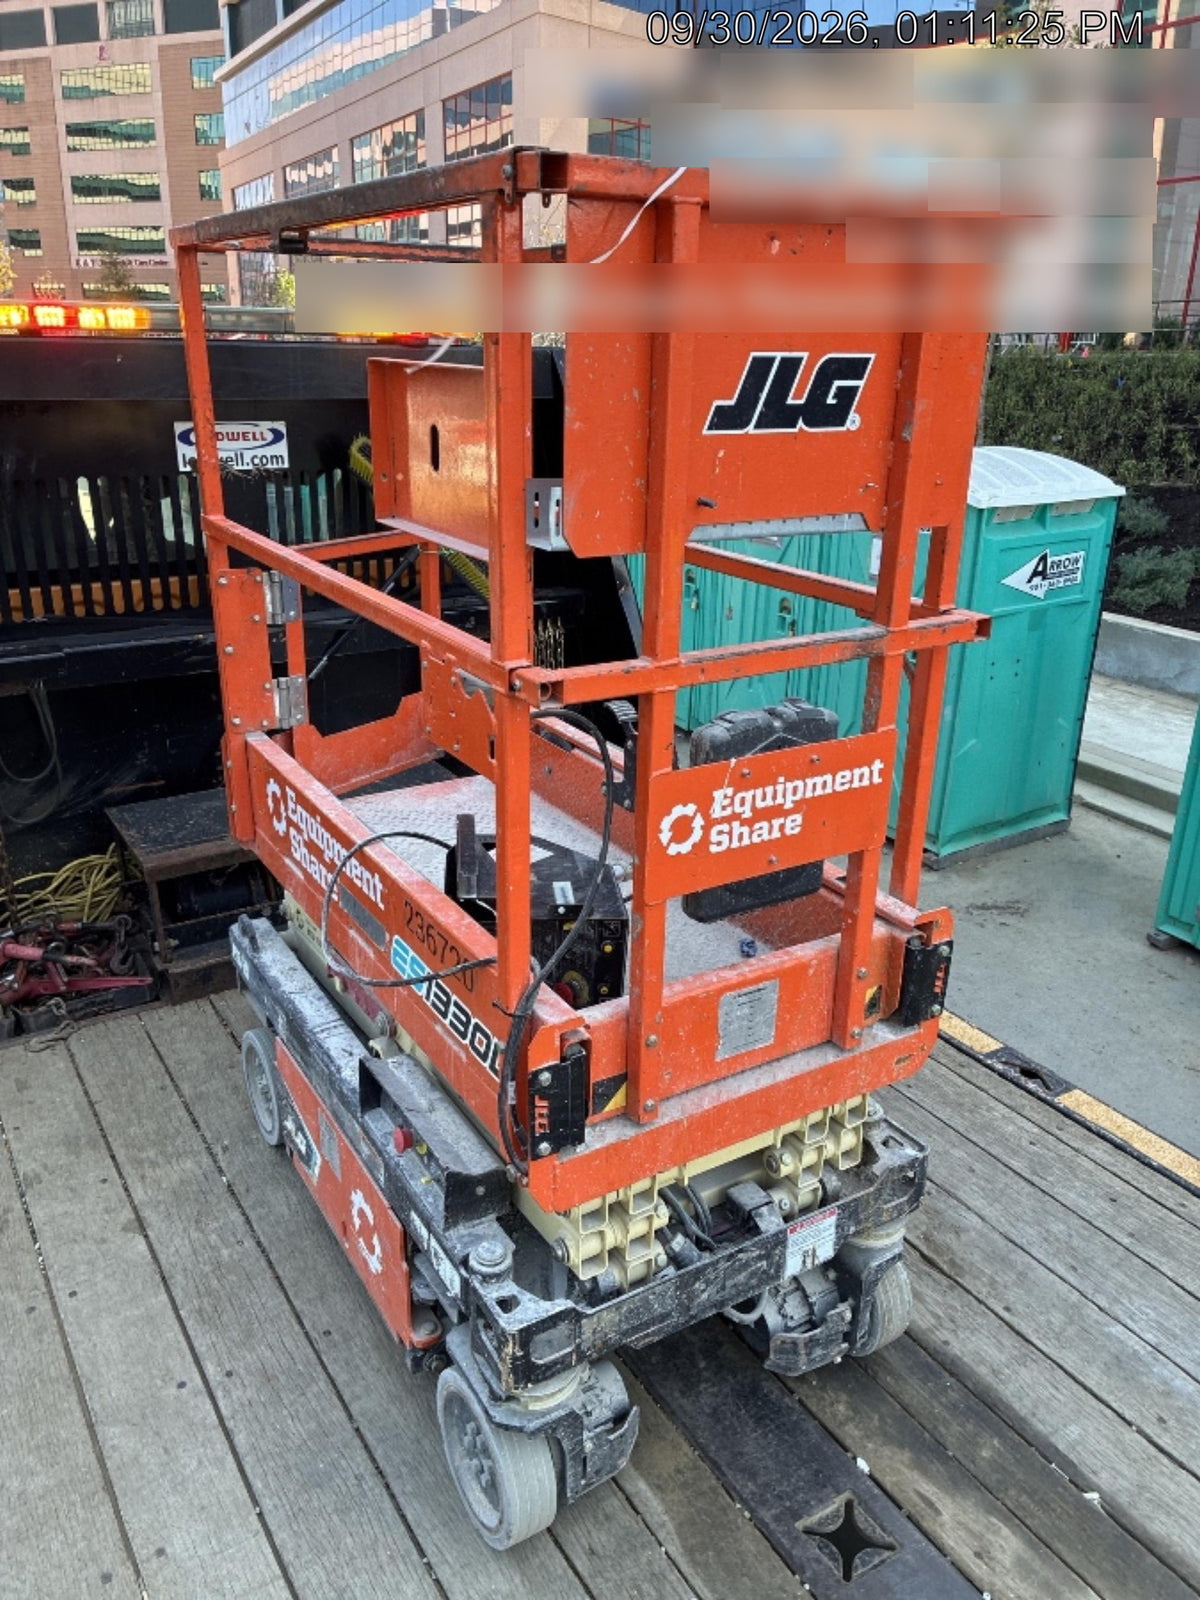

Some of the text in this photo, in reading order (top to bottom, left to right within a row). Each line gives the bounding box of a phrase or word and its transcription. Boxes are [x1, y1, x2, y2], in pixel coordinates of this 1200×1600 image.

[702, 352, 877, 434] JLG
[182, 450, 285, 468] lell.com
[1026, 553, 1082, 584] ARROW
[709, 758, 885, 819] Equipment
[285, 786, 385, 911] Equipment
[708, 812, 803, 854] Share
